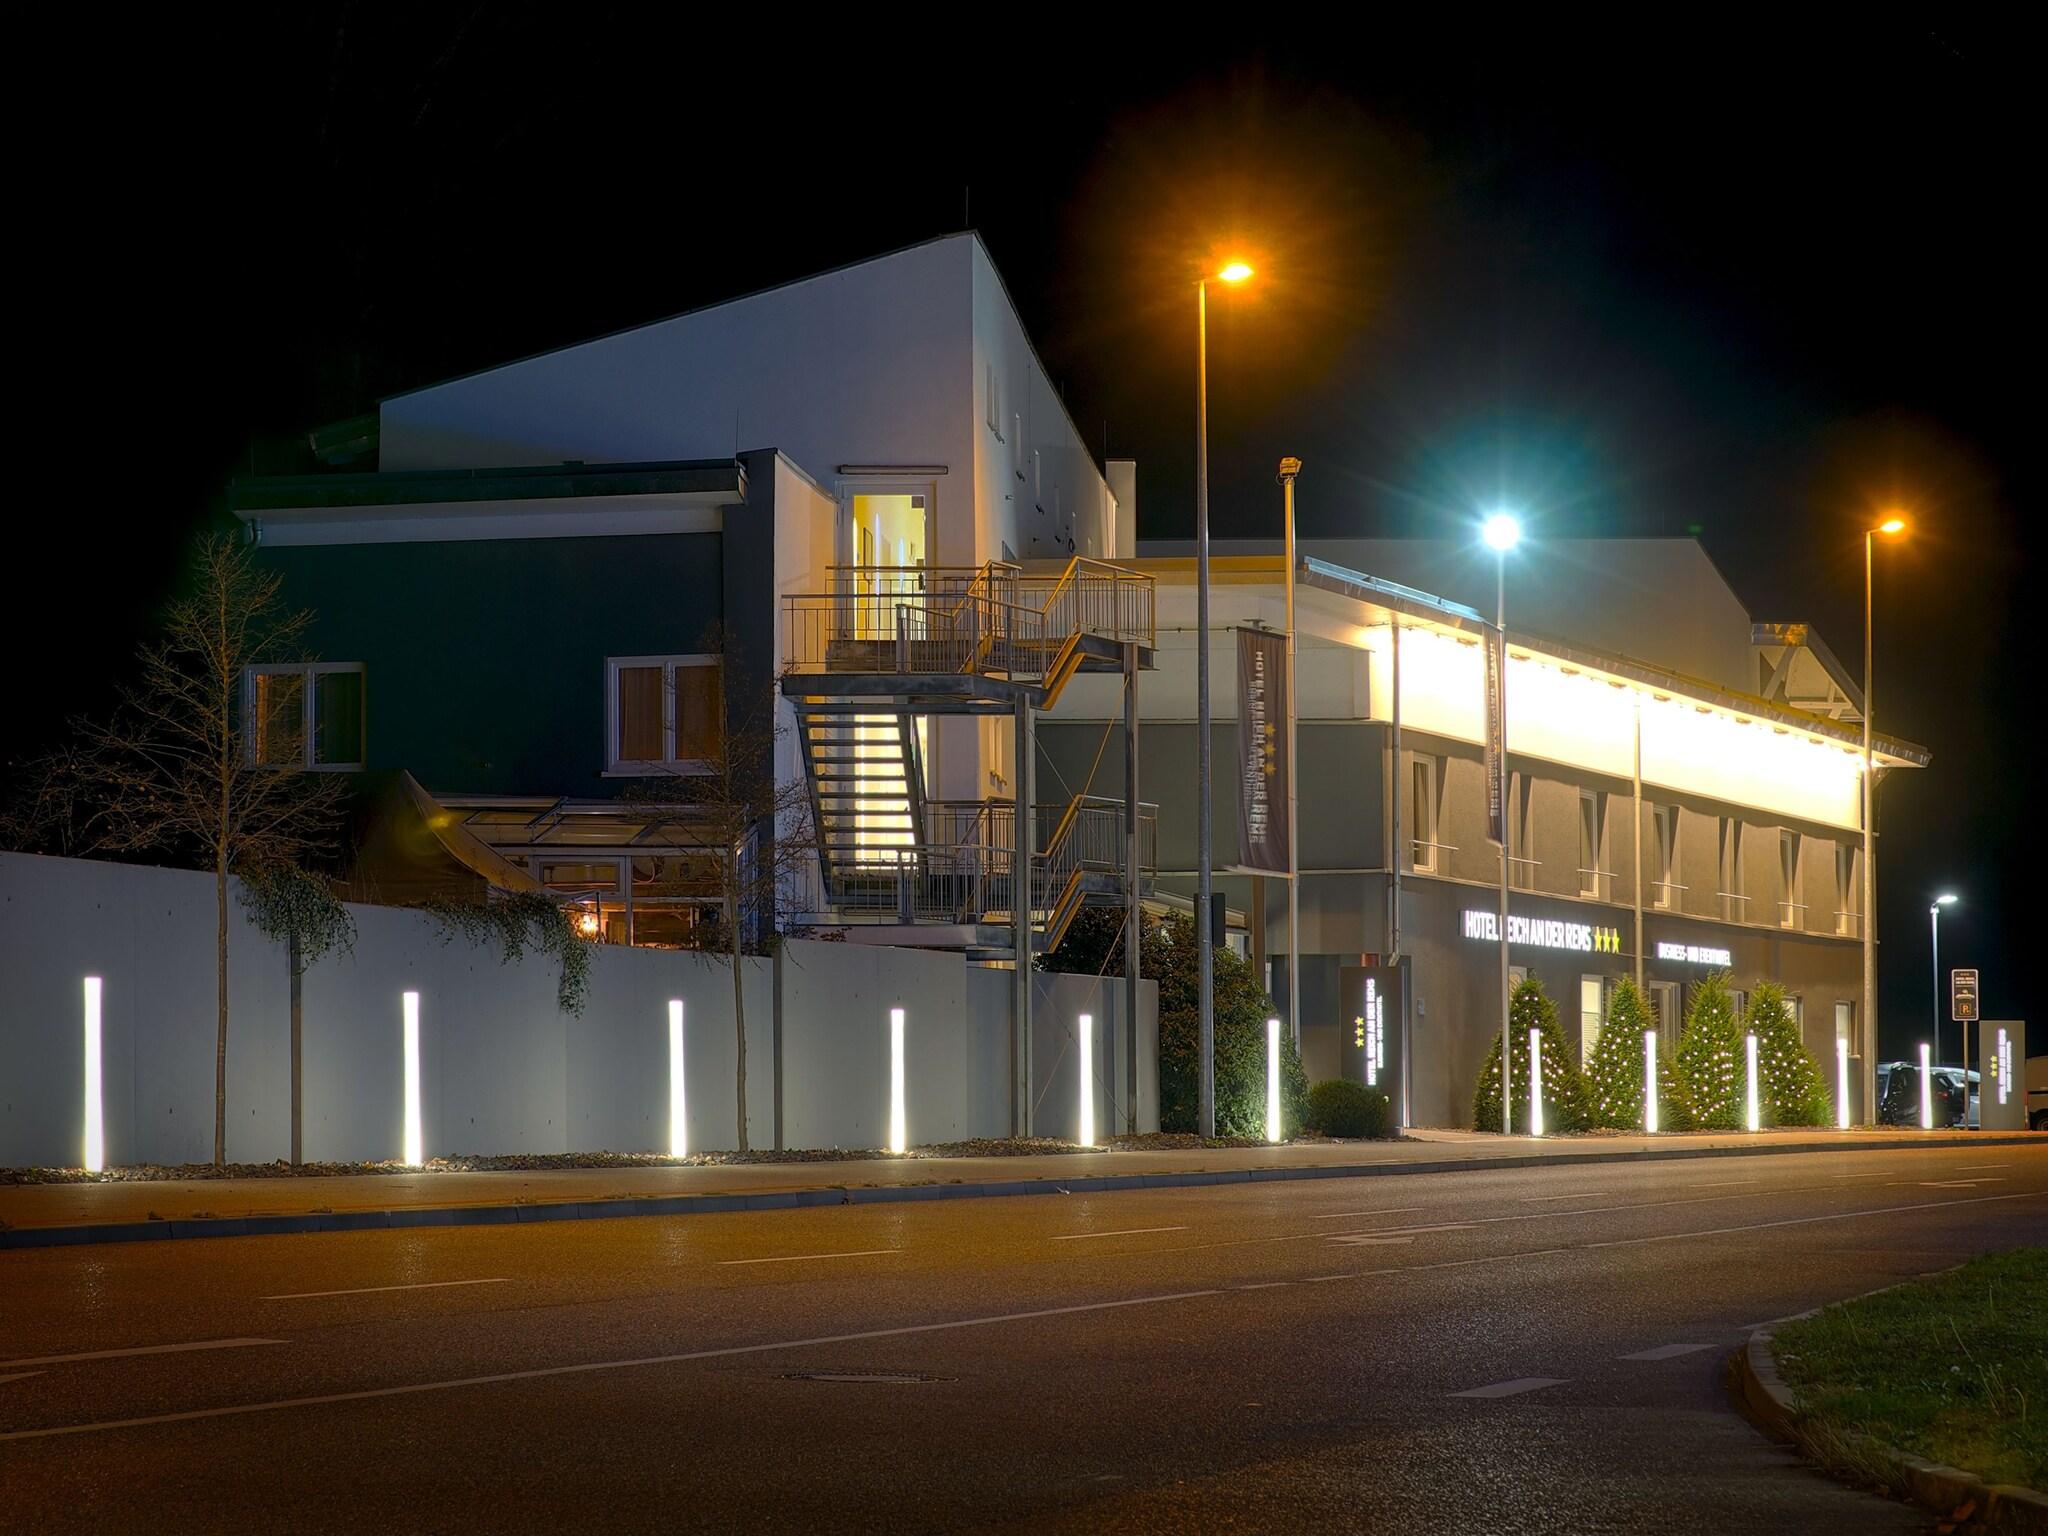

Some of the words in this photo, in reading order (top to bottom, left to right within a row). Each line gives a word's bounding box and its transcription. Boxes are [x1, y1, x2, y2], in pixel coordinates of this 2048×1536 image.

[1255, 651, 1265, 697] HOTEL
[1465, 911, 1499, 941] HOTEL
[1499, 915, 1529, 944] EICH
[1529, 919, 1544, 946] AN
[1545, 921, 1565, 948] DER
[1565, 923, 1591, 952] REMS
